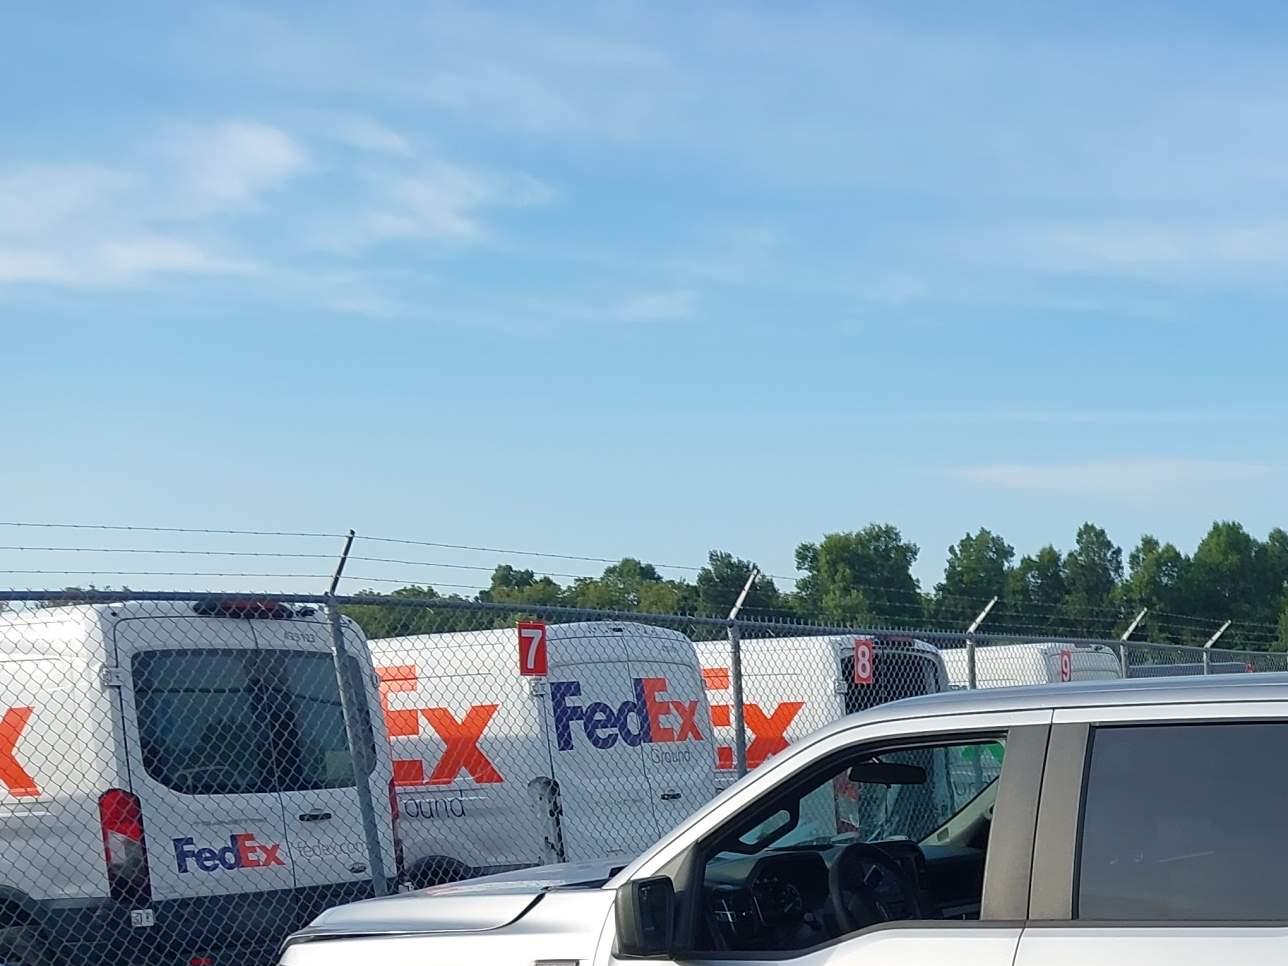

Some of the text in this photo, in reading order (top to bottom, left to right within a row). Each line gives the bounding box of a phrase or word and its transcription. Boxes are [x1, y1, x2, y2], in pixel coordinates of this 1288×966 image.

[519, 627, 545, 669] 7
[857, 645, 871, 678] 8
[1062, 655, 1071, 681] 9
[550, 677, 702, 751] FedEx
[172, 833, 286, 874] FedEx
